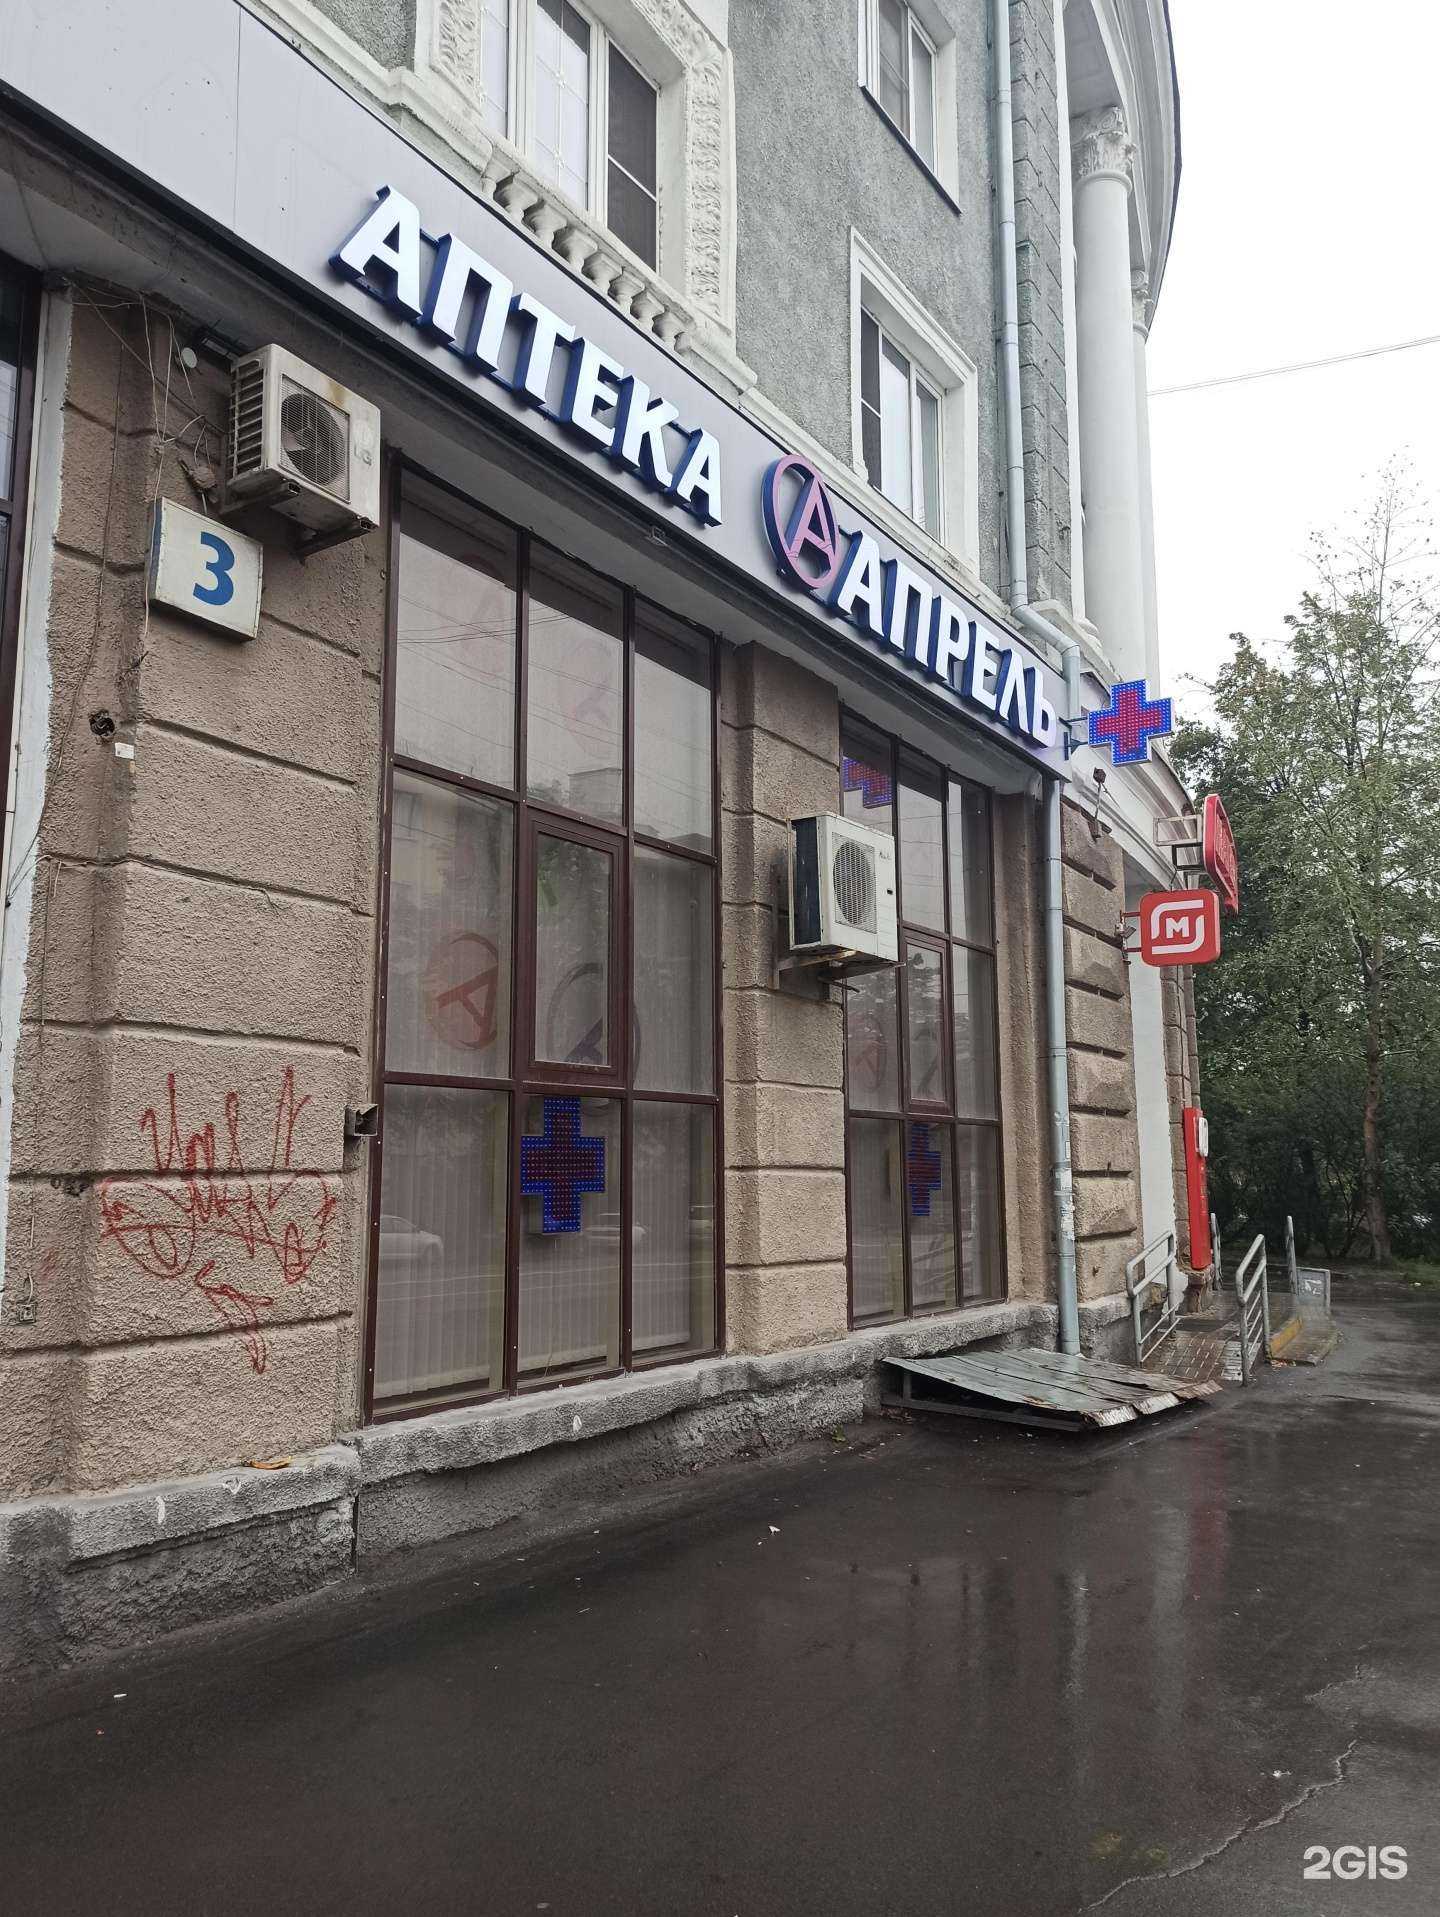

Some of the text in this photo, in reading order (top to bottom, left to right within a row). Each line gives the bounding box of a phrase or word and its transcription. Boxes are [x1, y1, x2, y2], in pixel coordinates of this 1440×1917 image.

[193, 531, 235, 606] 3
[330, 185, 722, 527] АПТЕКА
[832, 530, 1056, 748] АПРЕЛЬ
